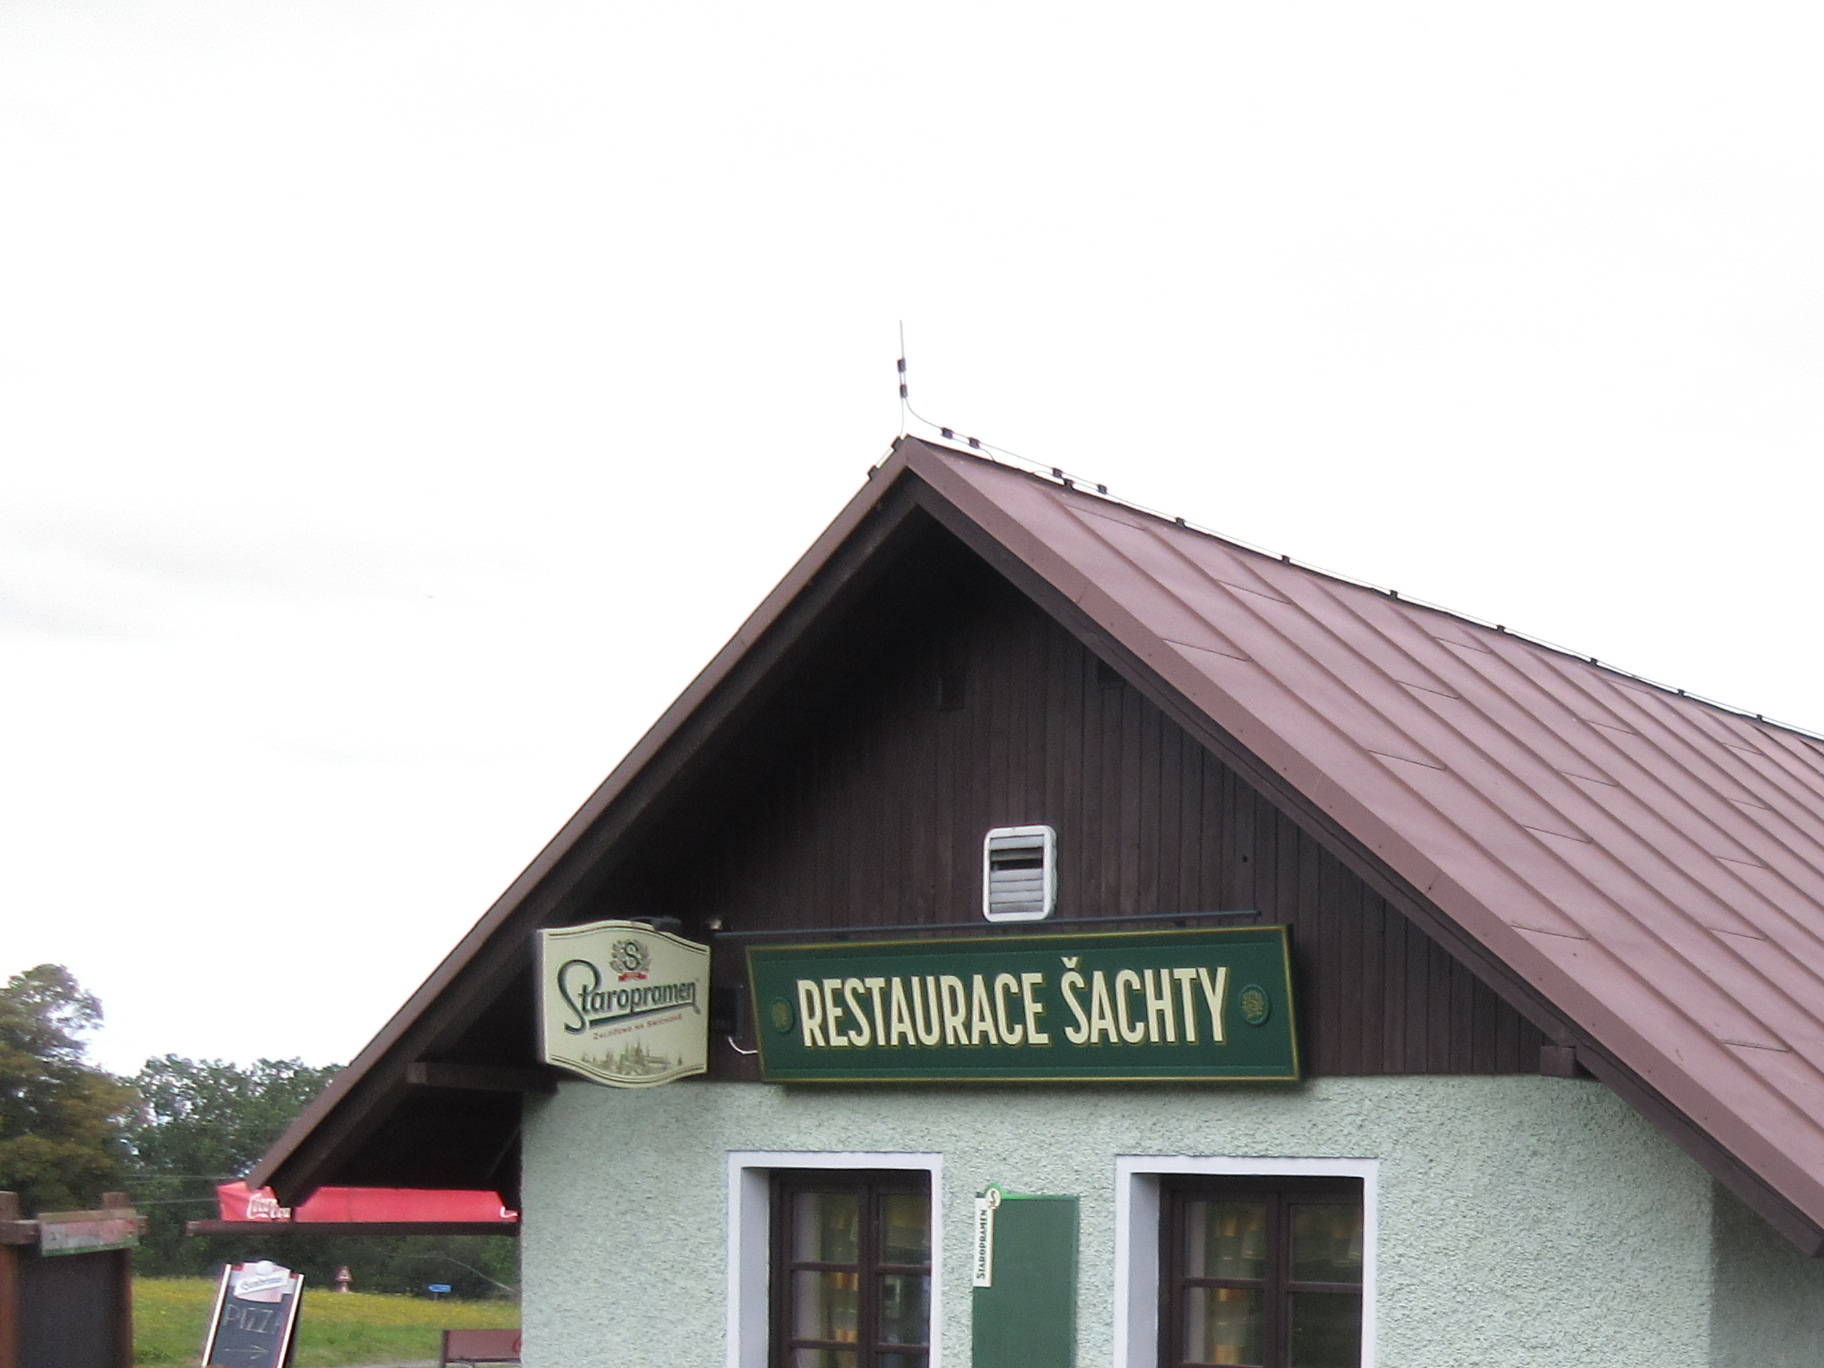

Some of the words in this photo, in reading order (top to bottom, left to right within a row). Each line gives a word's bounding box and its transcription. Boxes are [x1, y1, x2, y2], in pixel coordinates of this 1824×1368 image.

[557, 959, 698, 1033] Staropramen
[796, 971, 1050, 1048] RESTAURACE
[1060, 956, 1228, 1045] ŠACHTY
